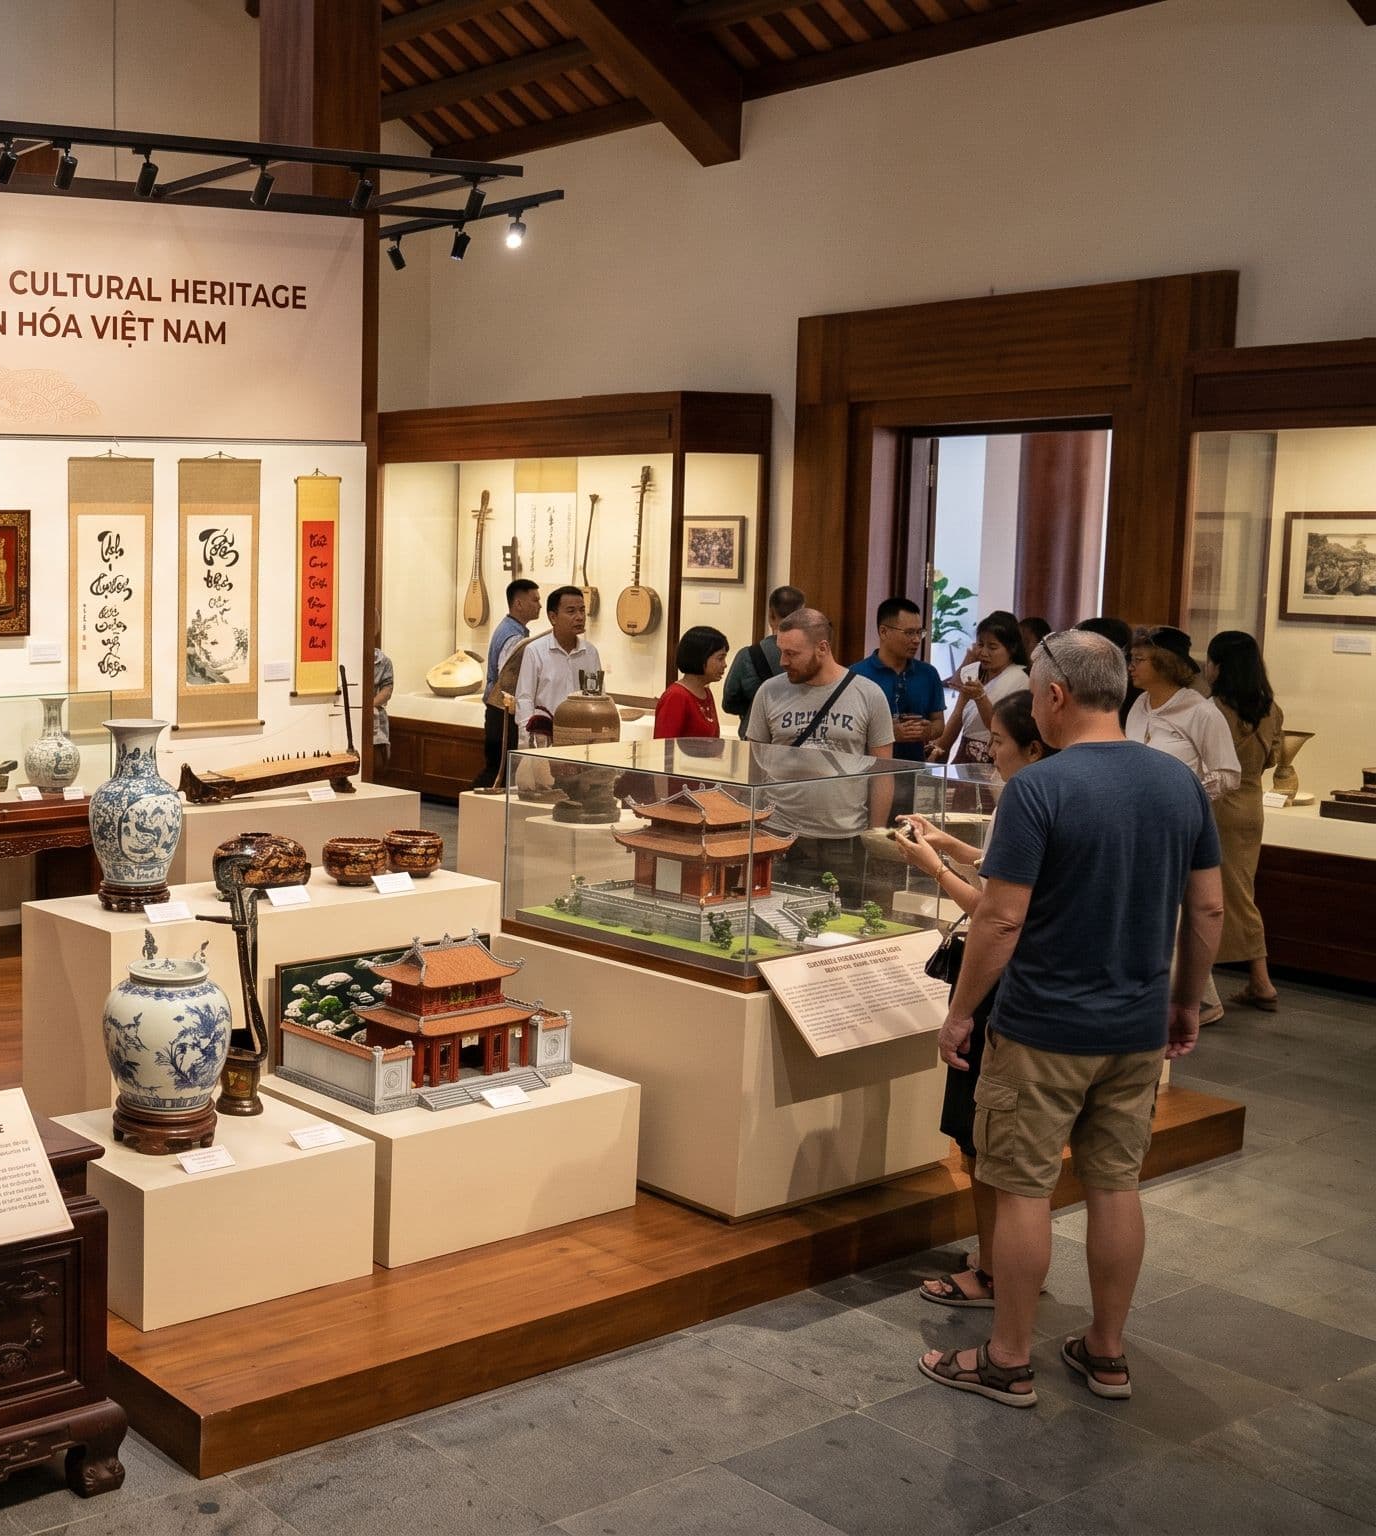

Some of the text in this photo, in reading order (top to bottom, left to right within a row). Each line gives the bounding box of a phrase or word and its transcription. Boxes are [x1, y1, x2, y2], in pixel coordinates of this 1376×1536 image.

[9, 269, 162, 302] CULTURAL
[171, 278, 308, 310] HERITAGE
[17, 306, 83, 339] HÓA
[90, 310, 155, 348] VIỆT
[163, 318, 226, 345] NAM
